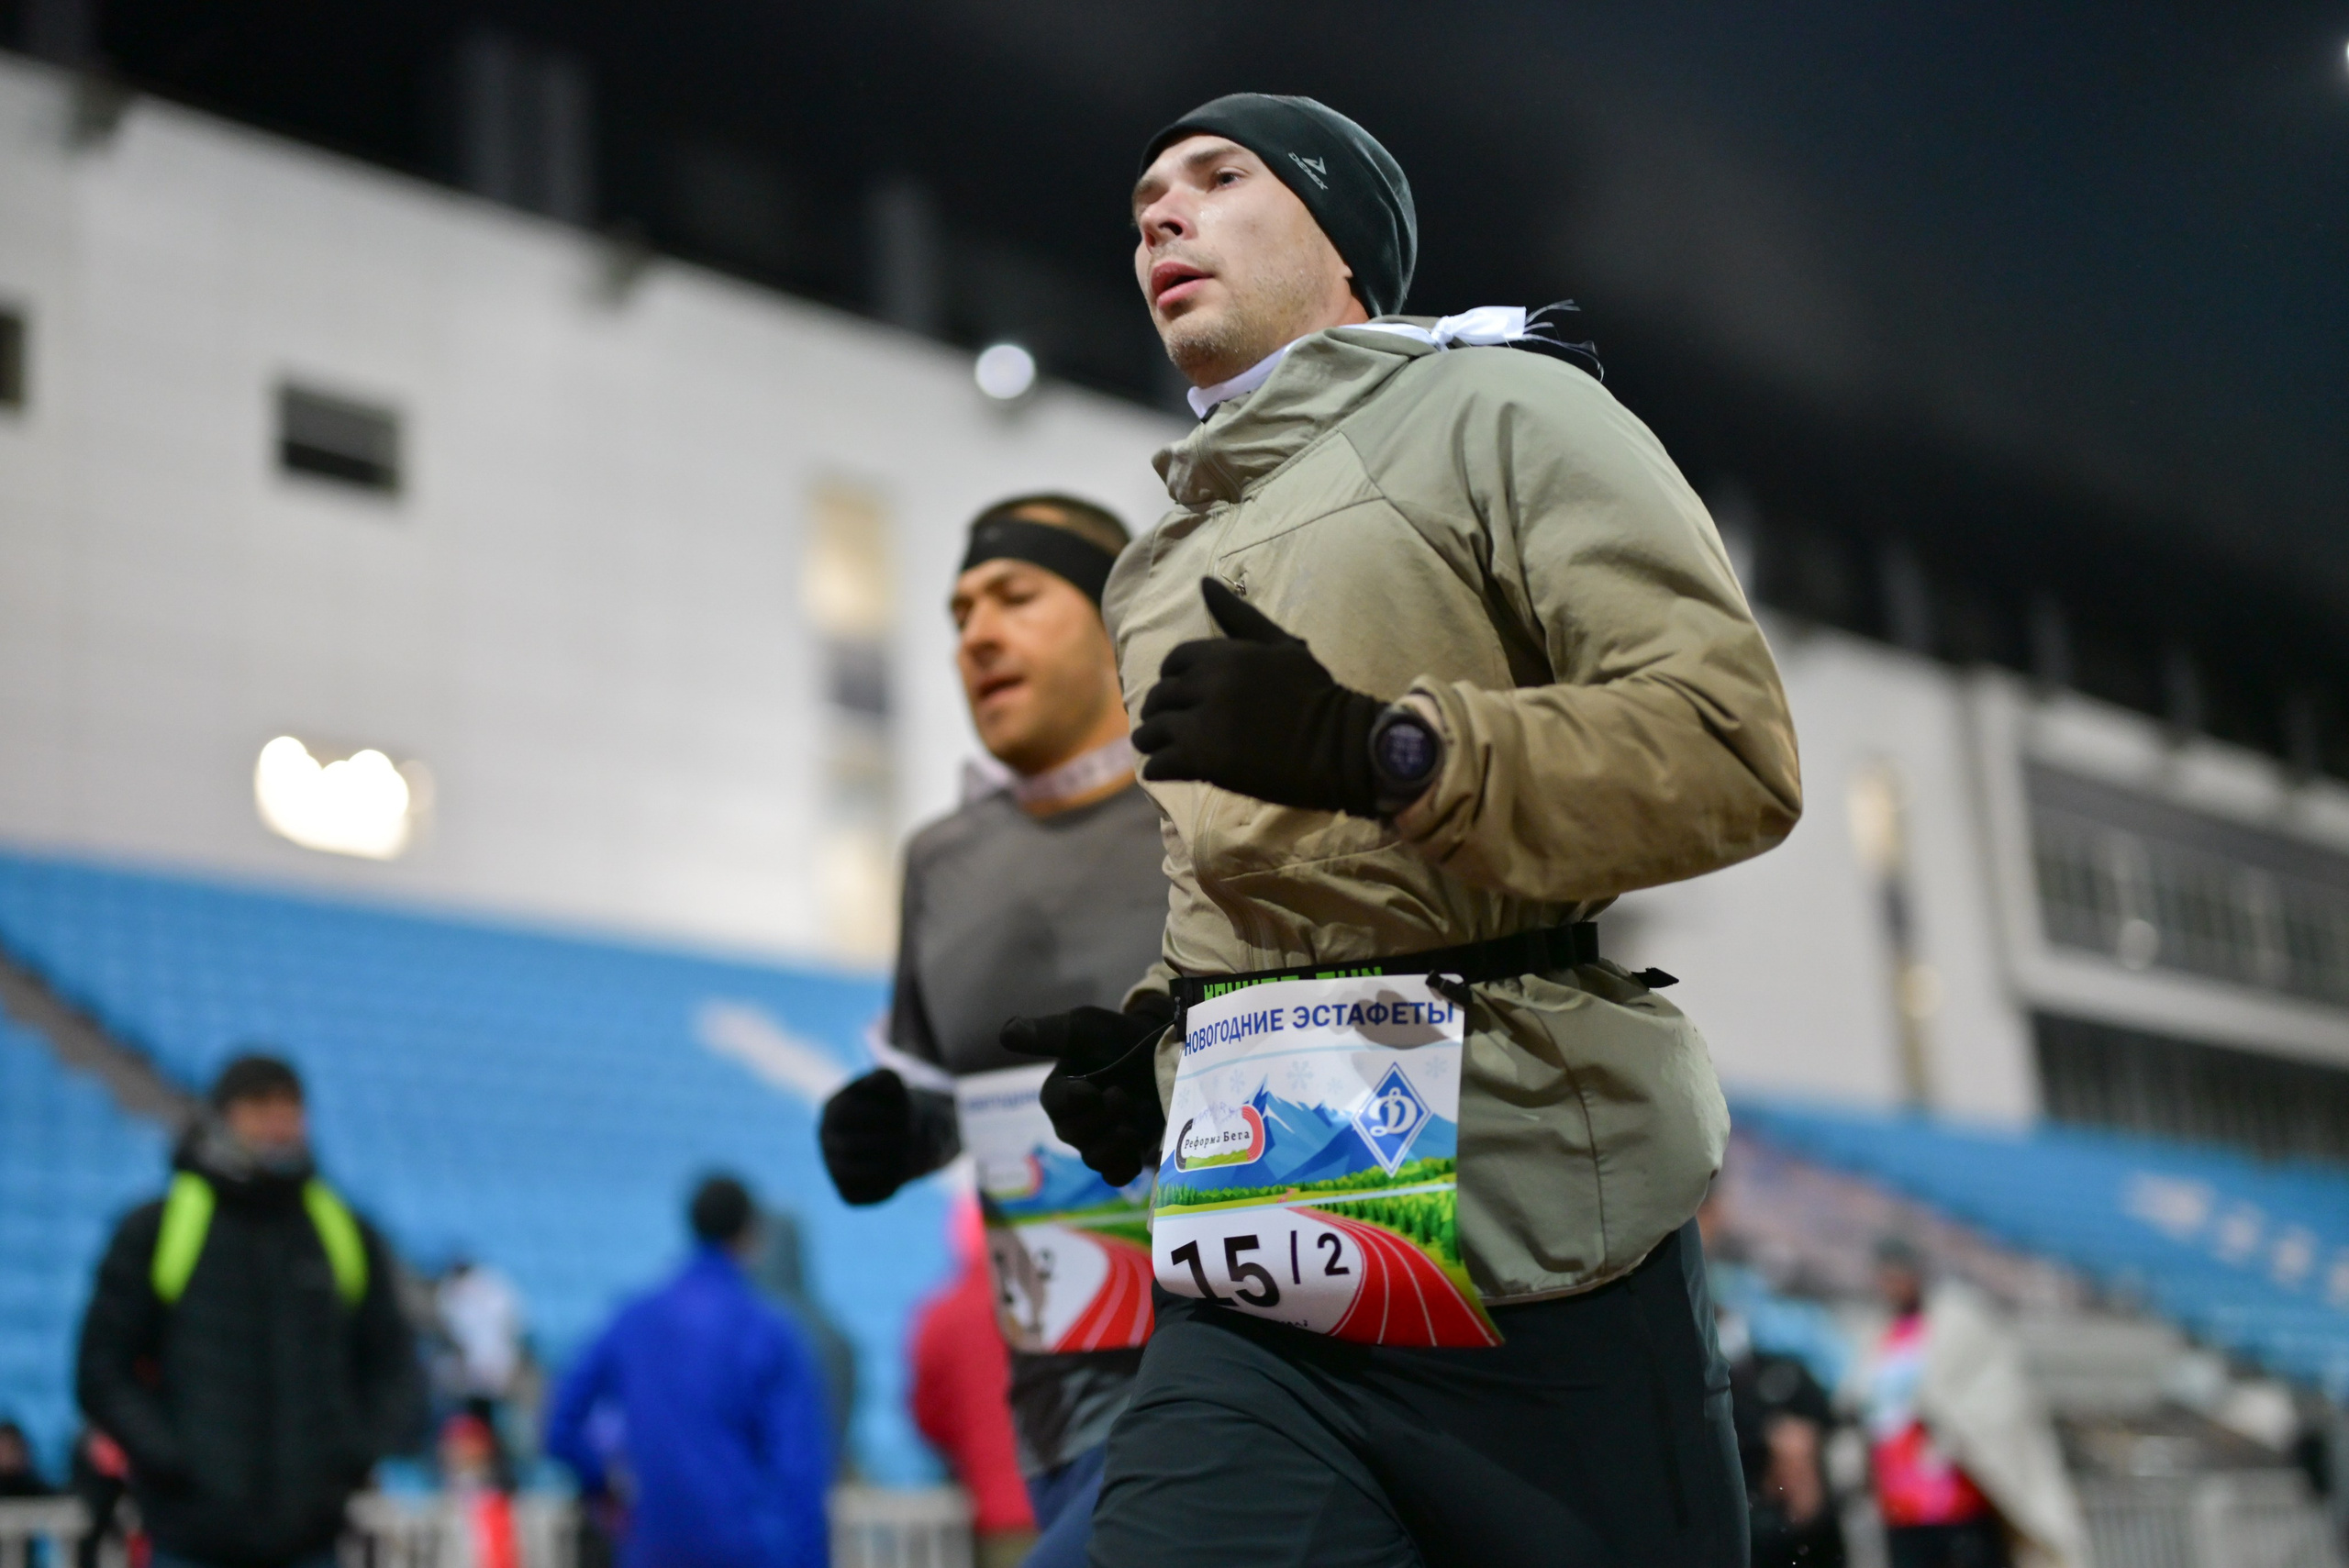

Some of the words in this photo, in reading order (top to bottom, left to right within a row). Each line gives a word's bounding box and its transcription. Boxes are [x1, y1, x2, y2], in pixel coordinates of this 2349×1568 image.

[1185, 1007, 1284, 1056] НОВОГОДНИЕ
[1292, 1002, 1454, 1029] ЭСТАФЕТЫ
[1184, 1135, 1220, 1150] Реформа
[1223, 1130, 1251, 1142] Бега
